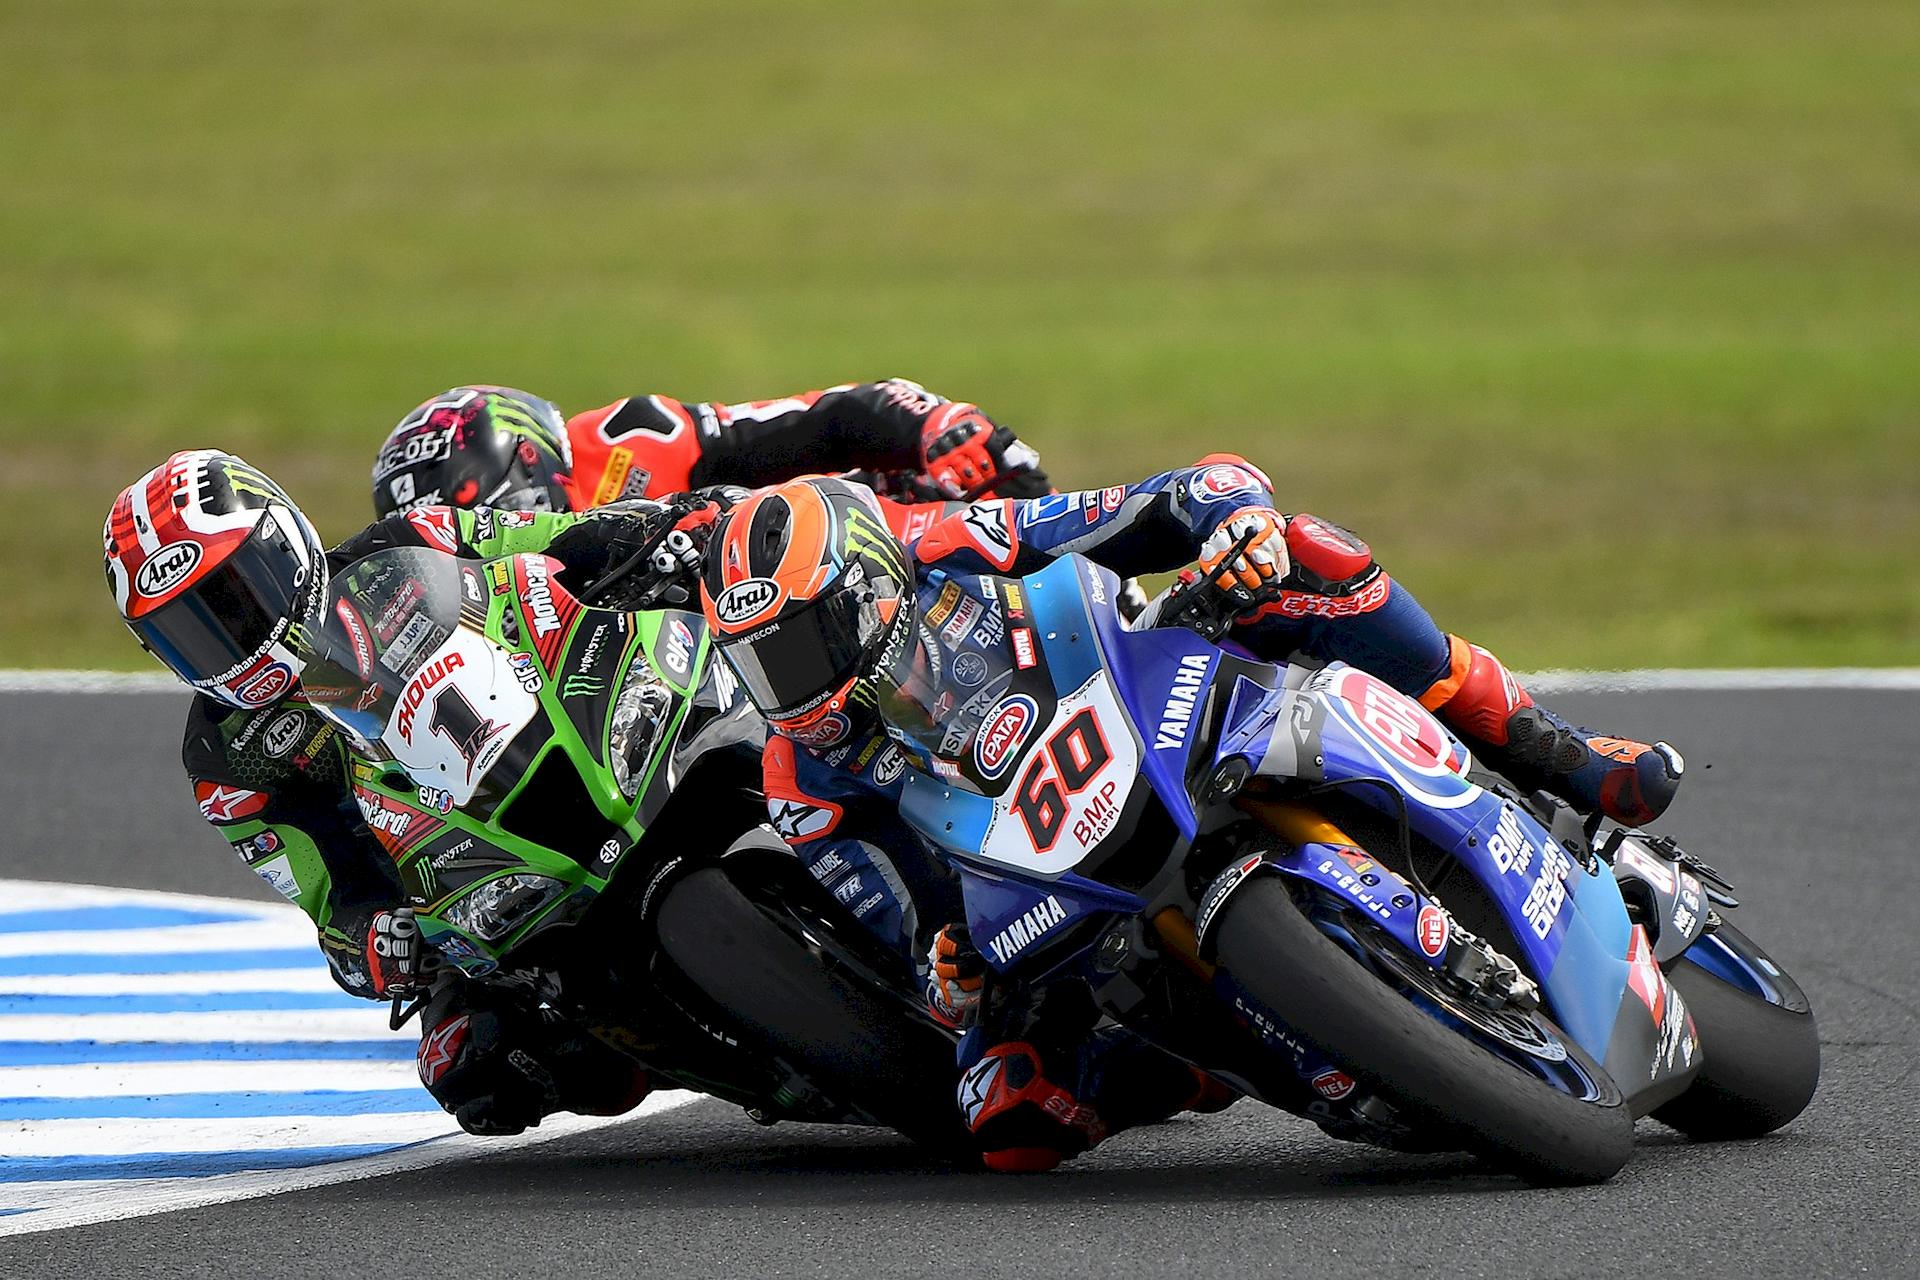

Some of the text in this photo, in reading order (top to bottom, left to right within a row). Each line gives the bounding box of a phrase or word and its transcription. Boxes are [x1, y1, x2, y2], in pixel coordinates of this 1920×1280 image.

[142, 544, 192, 594] Arai
[718, 583, 768, 619] Arai
[947, 597, 976, 634] YAMAHA
[578, 623, 608, 673] MONSTER
[869, 597, 910, 683] MONSTER
[1017, 630, 1034, 667] MOTUL
[249, 673, 282, 702] PATA
[398, 652, 465, 748] SHOWA
[1154, 655, 1211, 750] YAMAHA
[231, 706, 276, 751] Kawasa
[268, 713, 300, 753] Arai
[978, 707, 1001, 742] SNACK
[984, 713, 1021, 762] PATA
[1363, 680, 1424, 760] PATA
[1009, 705, 1115, 855] 60
[1073, 781, 1116, 848] BMP
[1091, 806, 1119, 844] TAPPI
[431, 838, 474, 869] MONSTER
[1487, 806, 1524, 874] BMP
[1317, 860, 1391, 919] PIRELLI
[989, 895, 1067, 964] YAMAHA
[1428, 913, 1441, 946] HEL
[1235, 997, 1305, 1054] PIRELLI
[1319, 1078, 1349, 1096] HEL
